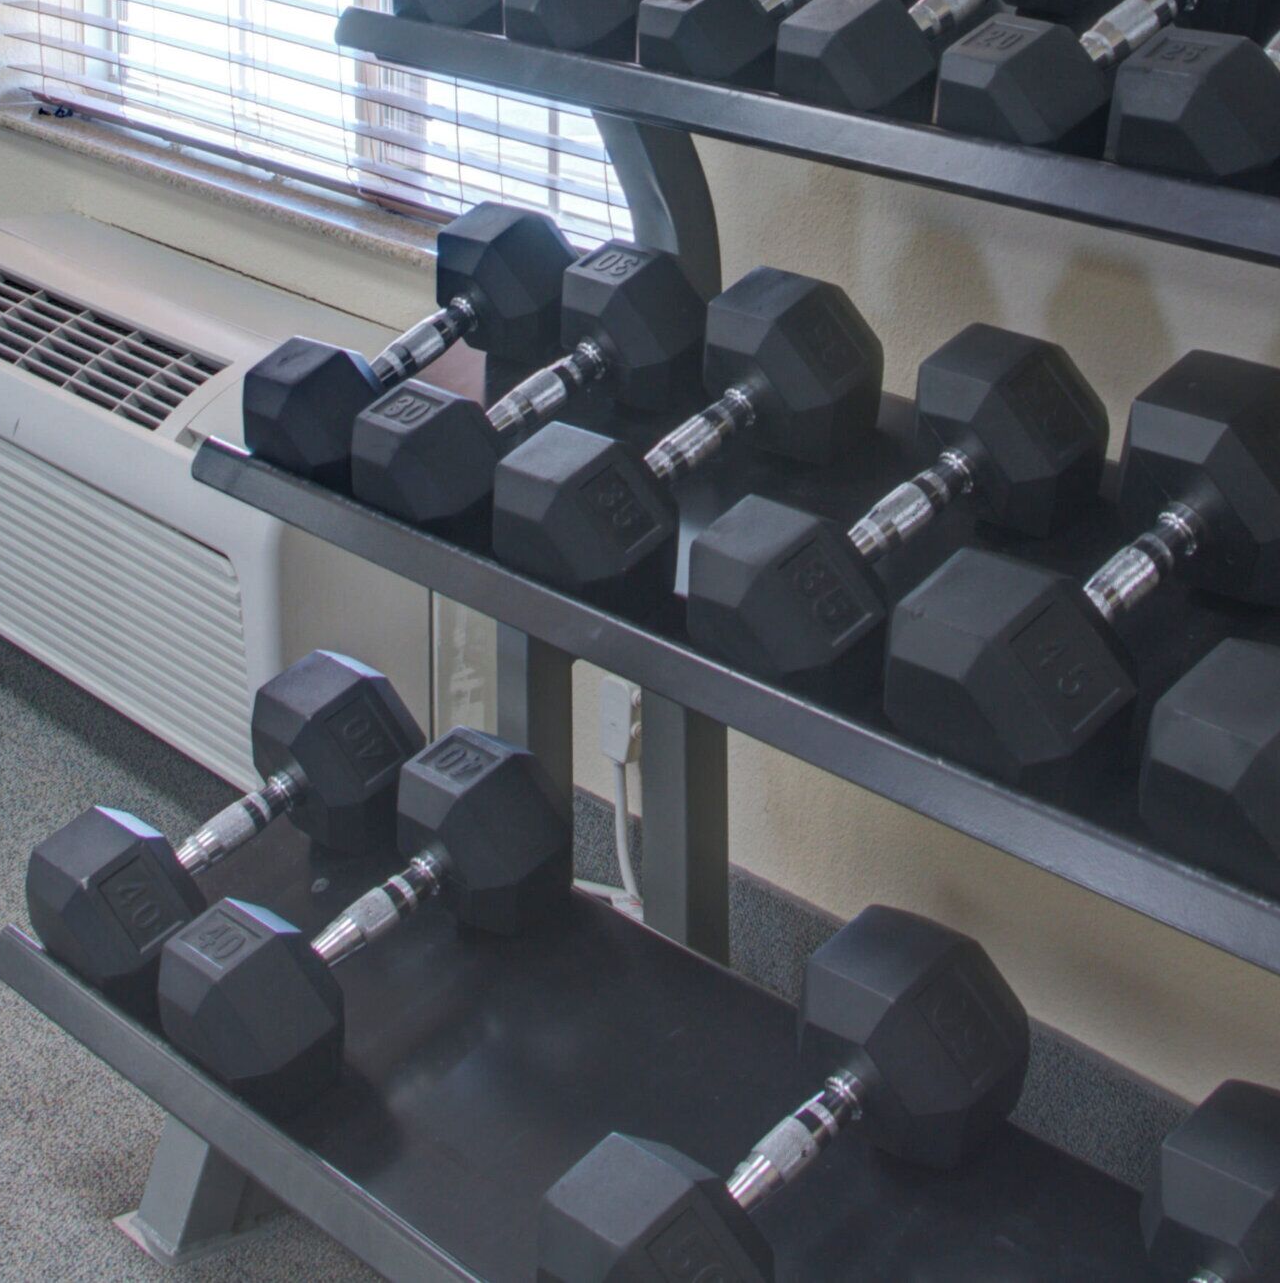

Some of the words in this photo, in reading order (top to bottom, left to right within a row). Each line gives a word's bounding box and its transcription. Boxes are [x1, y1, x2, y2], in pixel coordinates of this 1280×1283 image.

[976, 29, 1026, 51] 20
[1160, 42, 1209, 65] 25
[593, 251, 640, 276] 30
[384, 396, 433, 425] 30
[341, 715, 385, 760] 40
[435, 747, 484, 780] 40
[115, 880, 161, 931] 40
[198, 924, 247, 960] 40
